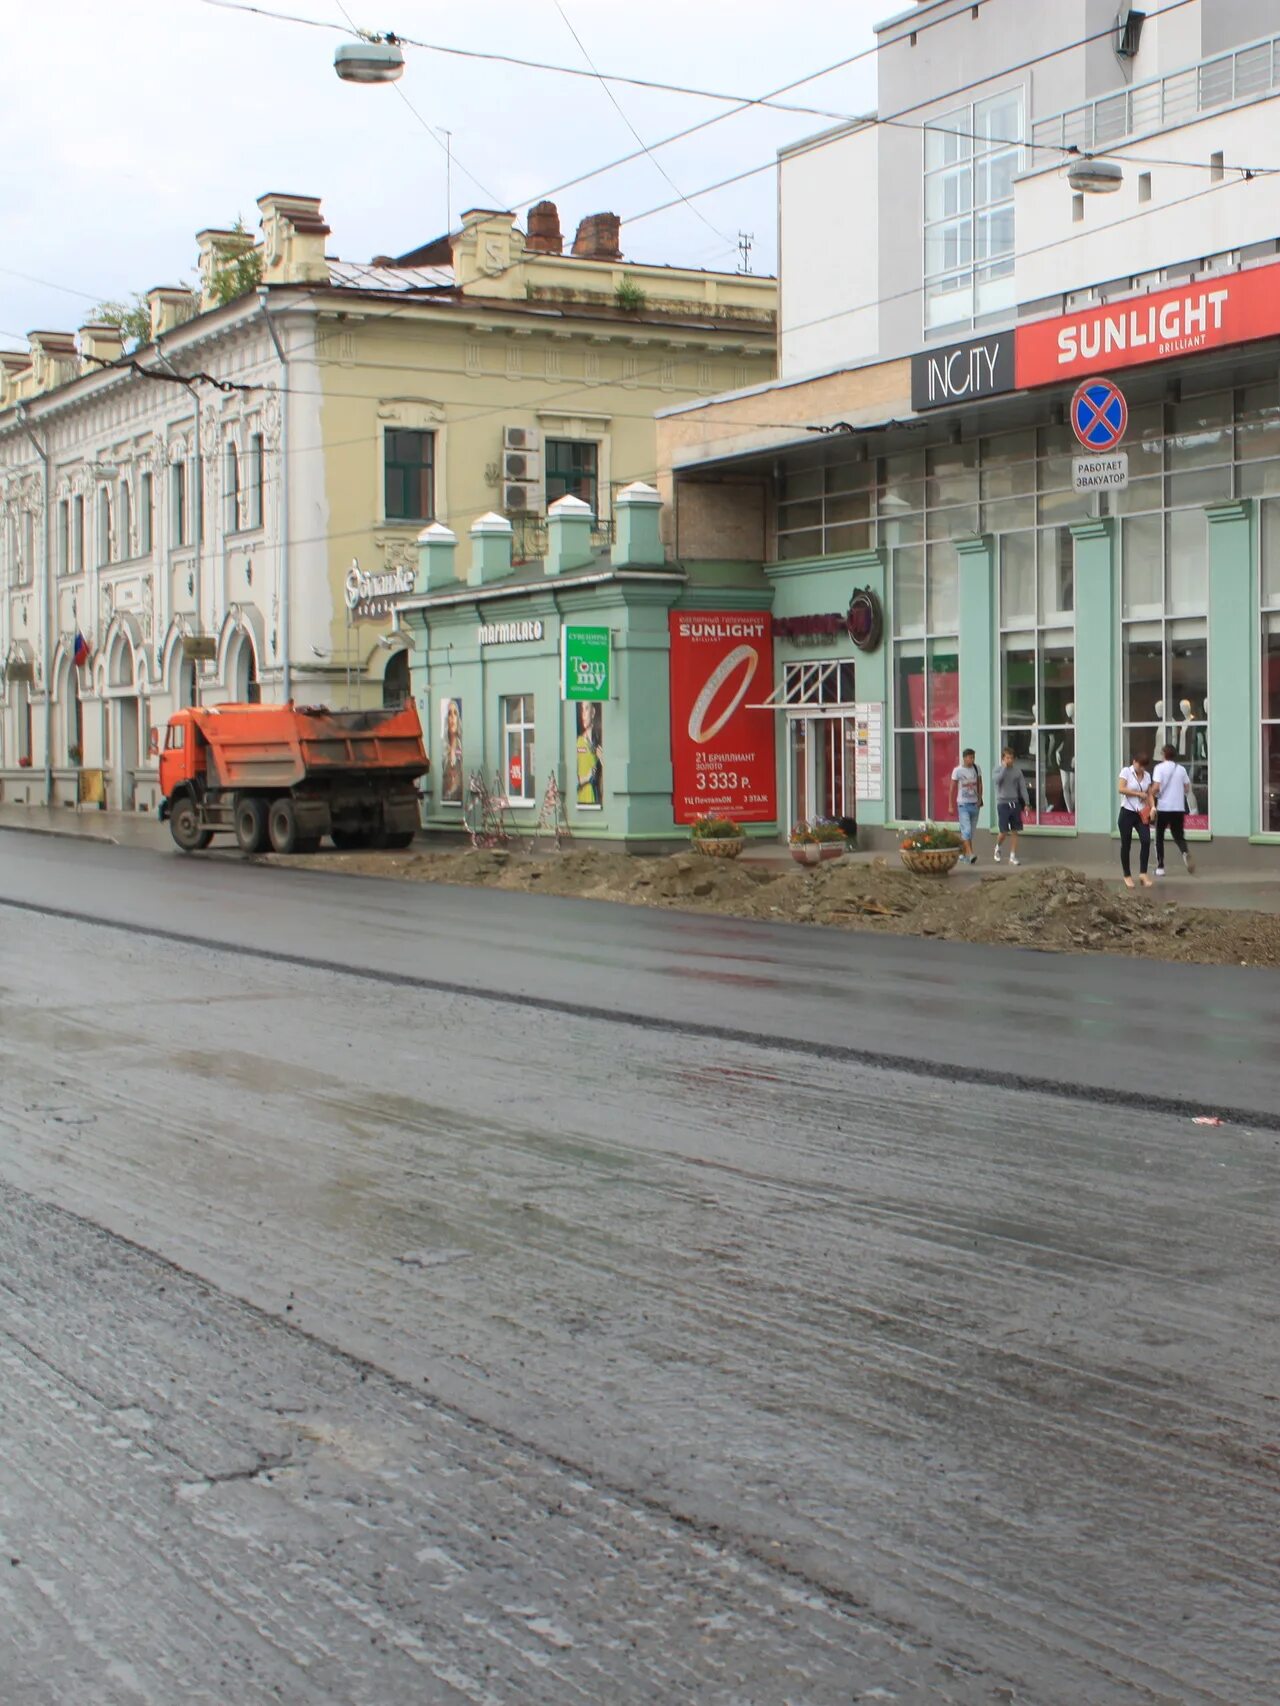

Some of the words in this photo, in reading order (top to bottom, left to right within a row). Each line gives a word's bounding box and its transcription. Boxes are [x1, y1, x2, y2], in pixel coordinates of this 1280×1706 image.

[1057, 289, 1229, 364] SUNLIGHT
[1159, 333, 1206, 354] BRILLIANT
[928, 342, 999, 401] INCITY
[1078, 461, 1122, 473] РАБОТАЕТ
[1077, 473, 1125, 487] ЭВАКУАТОР
[679, 624, 764, 637] SUNLIGHT
[570, 656, 606, 674] Tom
[576, 673, 607, 690] my
[695, 752, 706, 762] 21
[708, 753, 756, 762] БРИЛЛИАНТ
[696, 773, 706, 790] 3
[709, 772, 738, 789] 333
[684, 797, 694, 805] ТЦ
